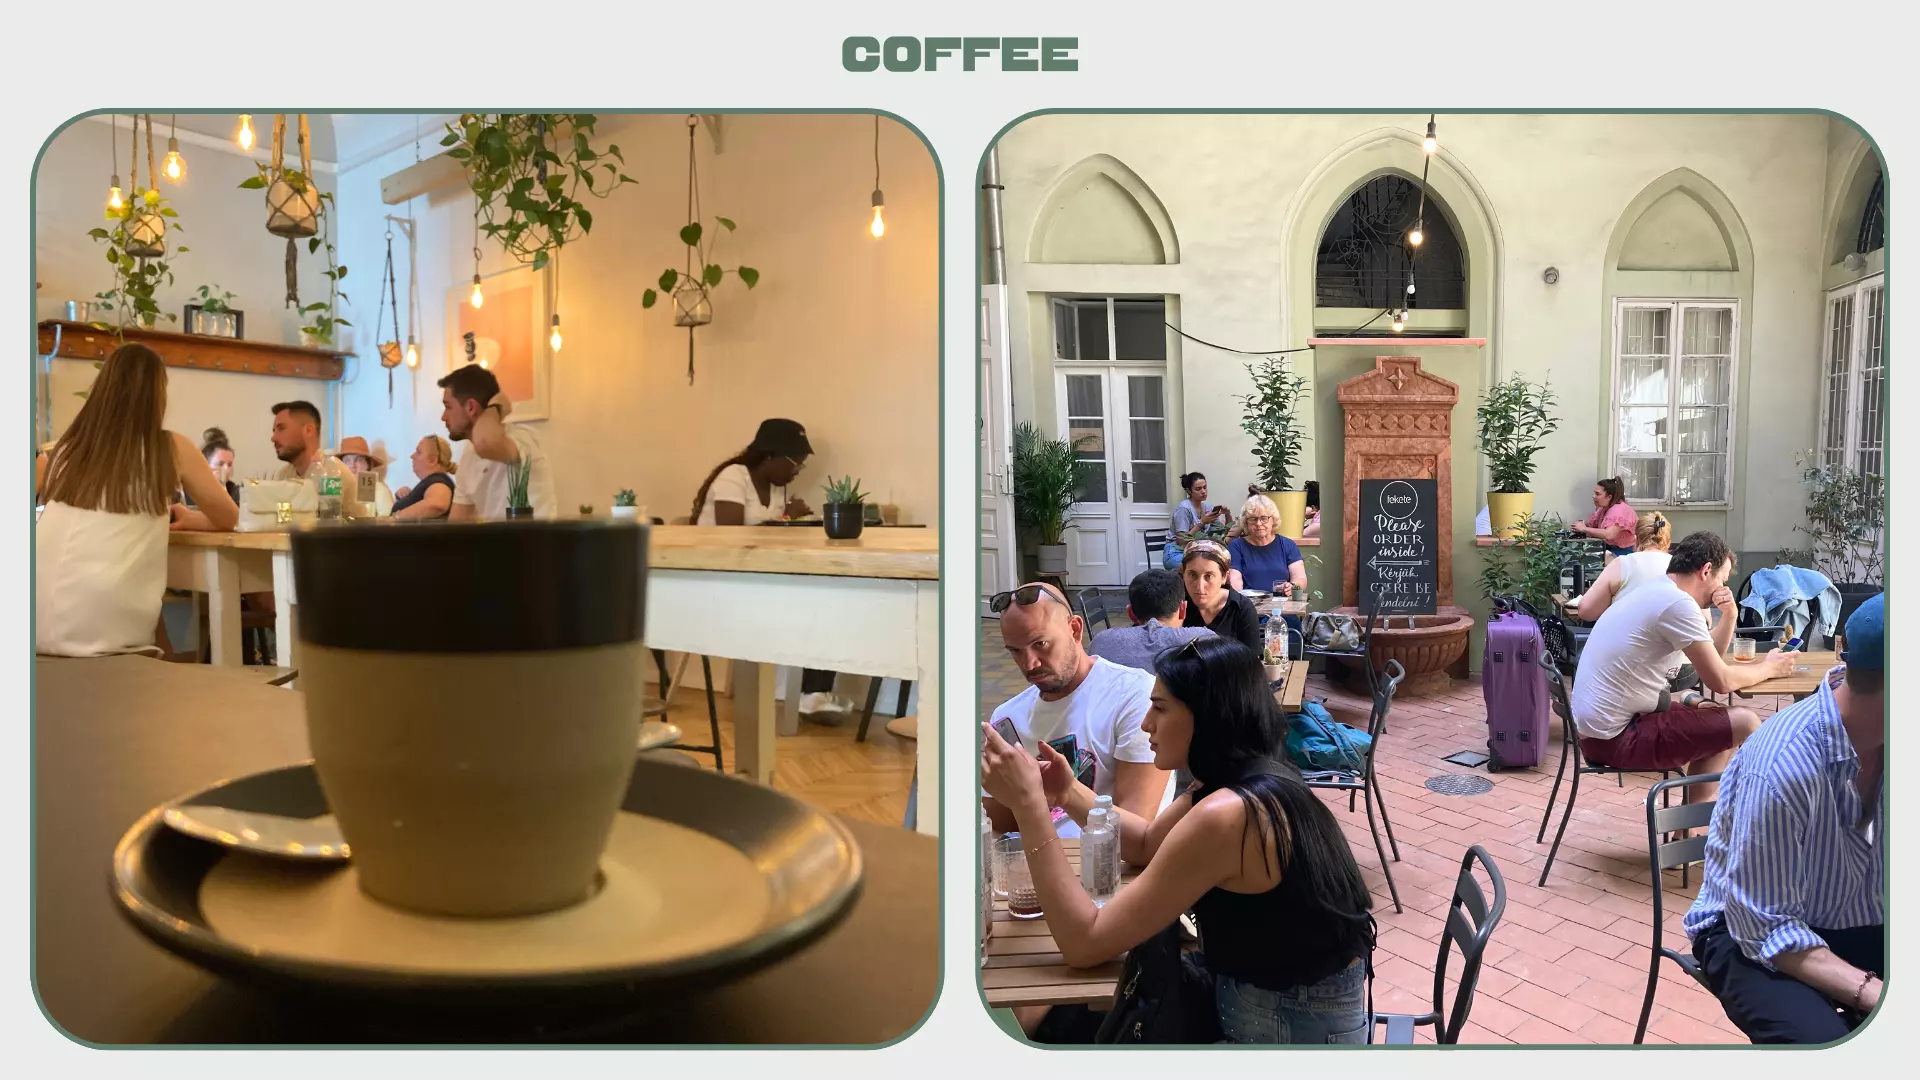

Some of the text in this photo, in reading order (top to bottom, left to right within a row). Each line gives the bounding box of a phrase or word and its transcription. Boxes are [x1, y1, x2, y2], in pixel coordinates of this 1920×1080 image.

[362, 477, 373, 486] 15
[1387, 495, 1412, 504] fekete
[1374, 514, 1425, 532] Please
[1373, 533, 1424, 544] ORDER
[1415, 582, 1432, 594] BE
